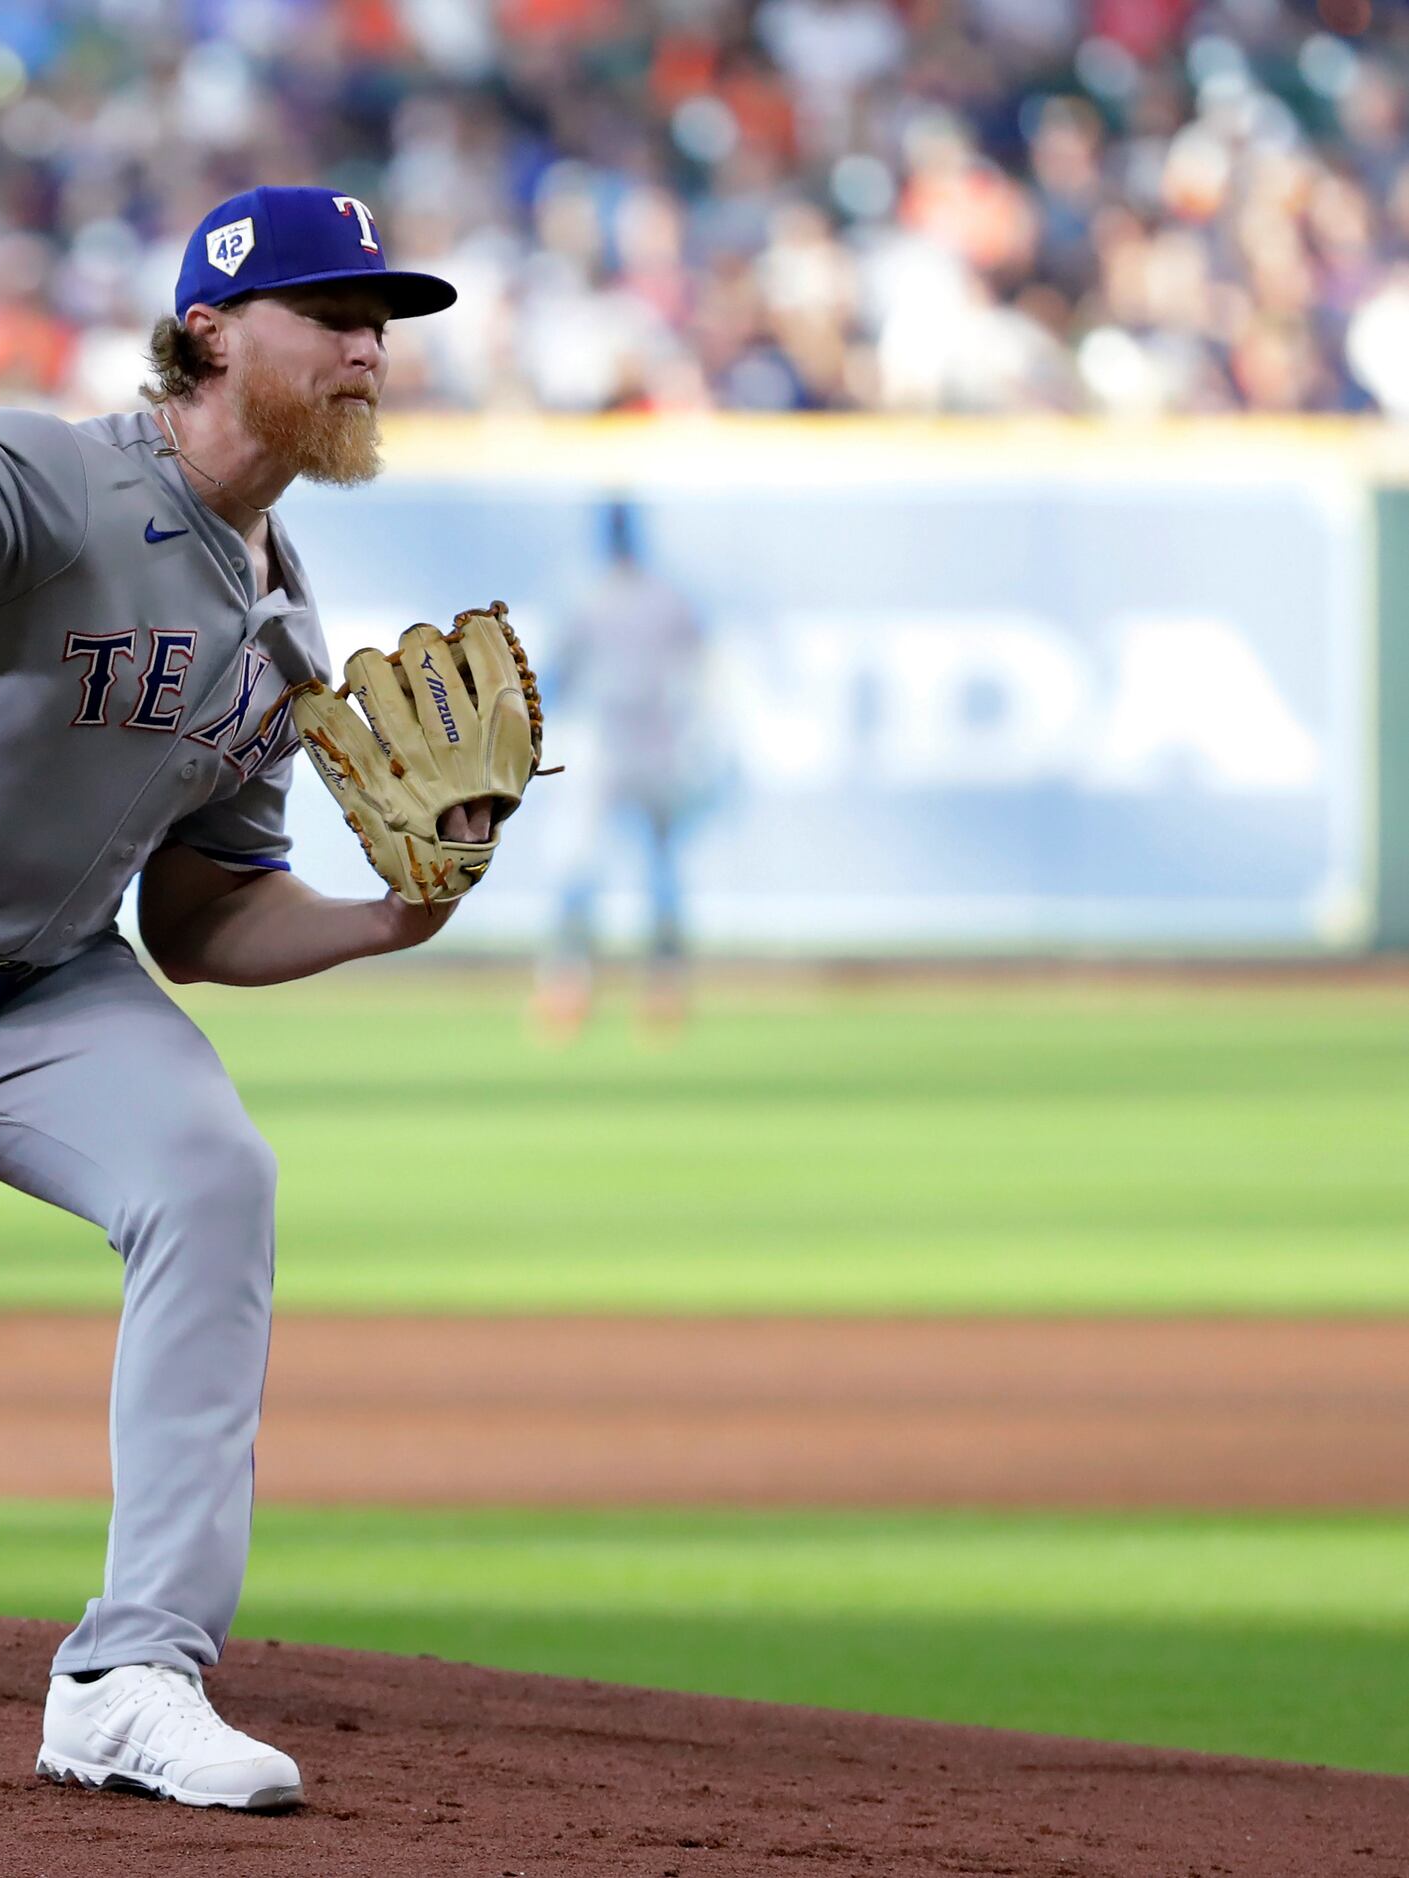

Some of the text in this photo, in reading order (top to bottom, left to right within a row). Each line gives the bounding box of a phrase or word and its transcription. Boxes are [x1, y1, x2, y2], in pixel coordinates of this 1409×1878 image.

[215, 234, 245, 261] 42
[331, 195, 379, 256] T
[61, 627, 303, 784] TEXA
[426, 676, 461, 744] MIZUNO
[700, 612, 1327, 792] NDA
